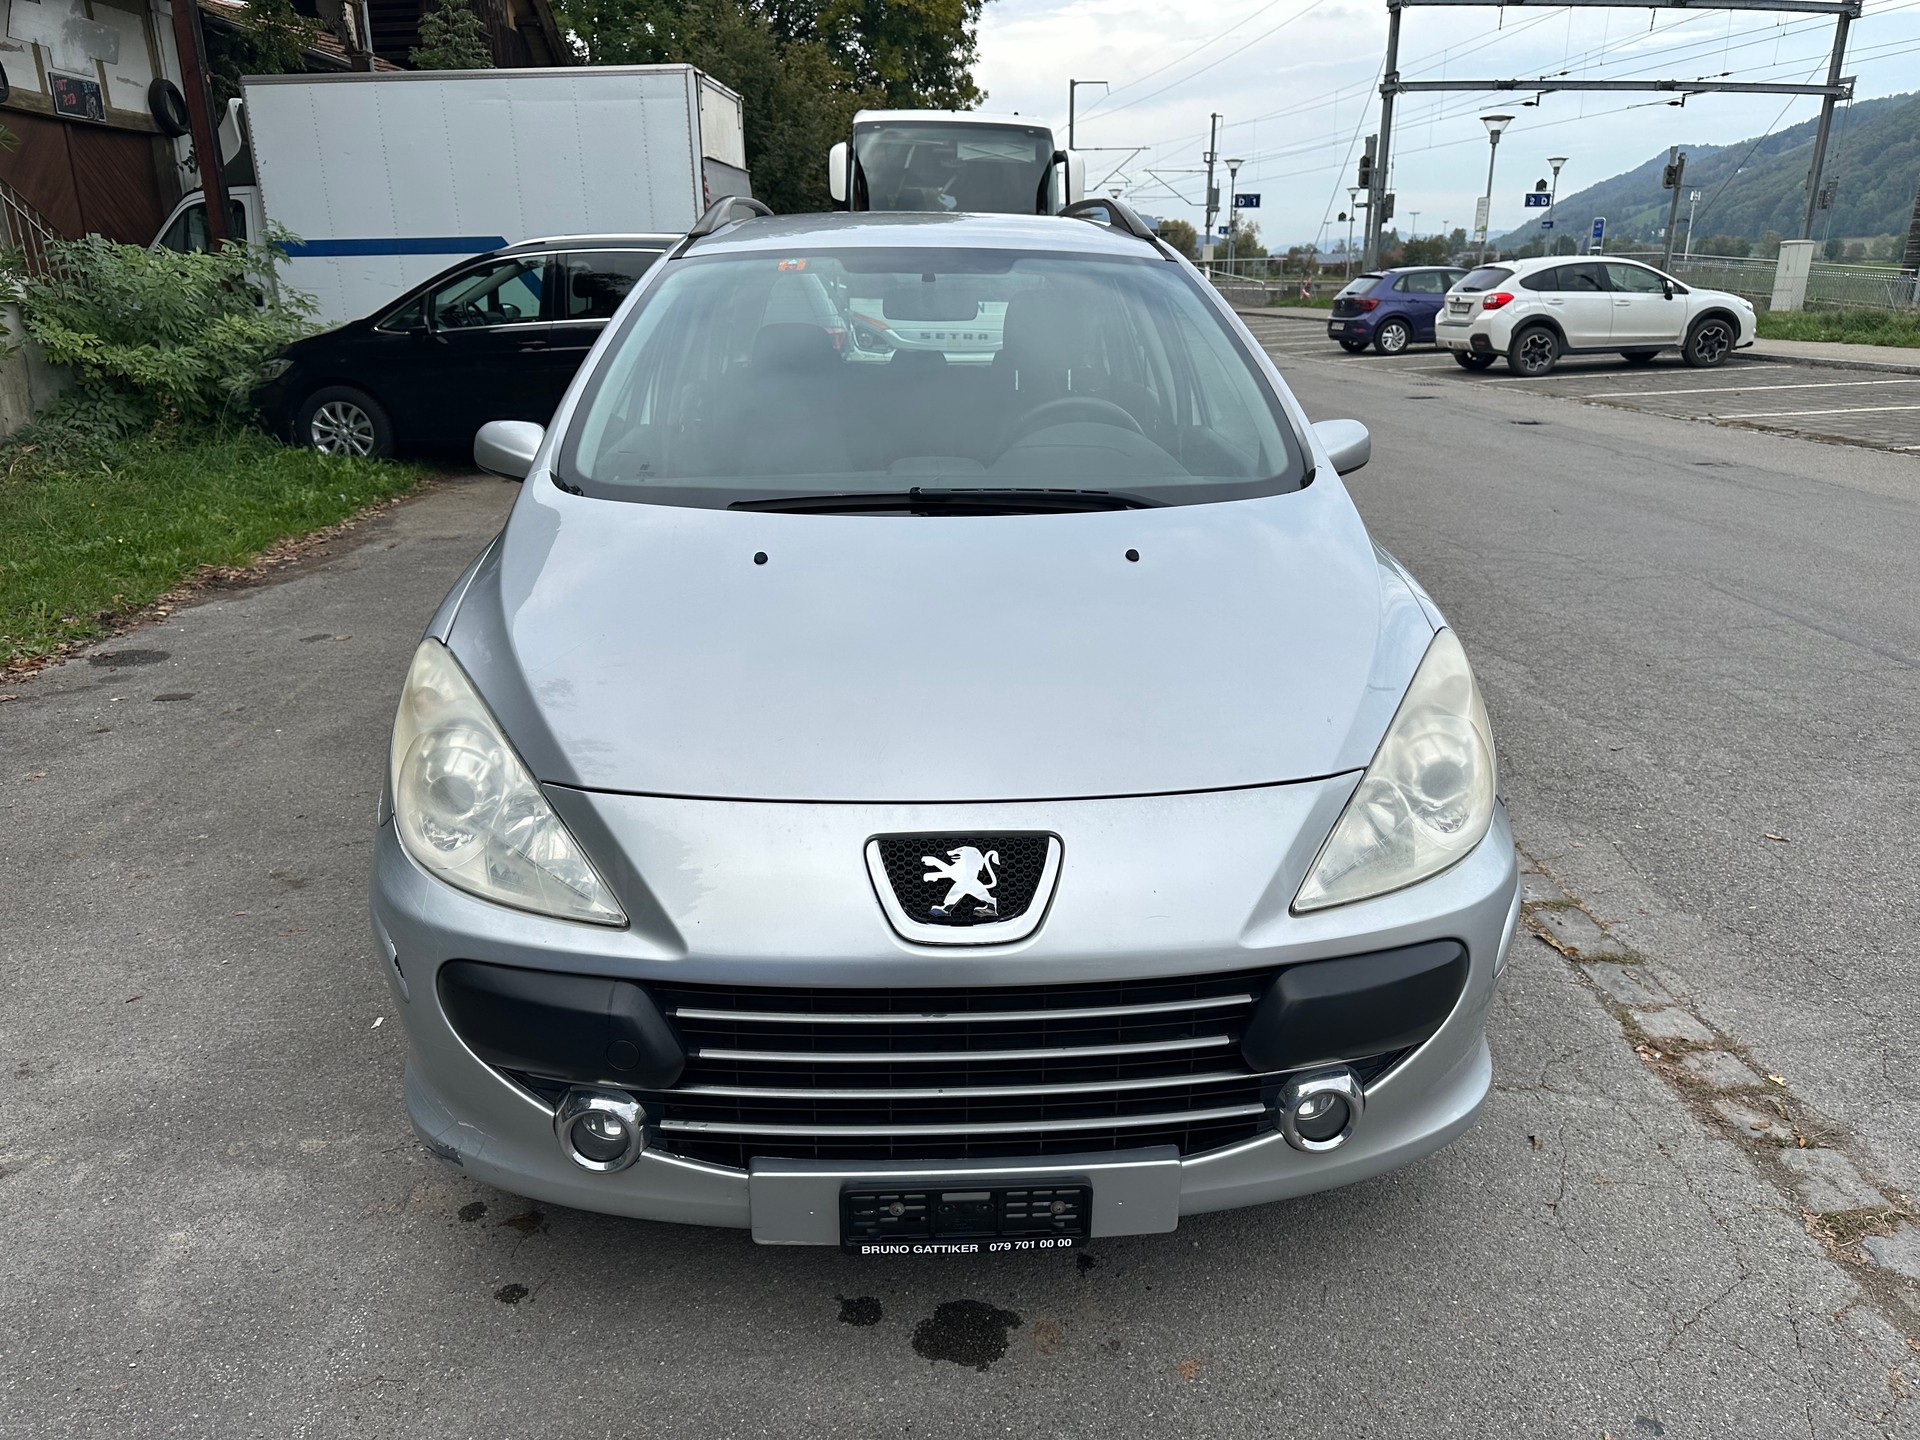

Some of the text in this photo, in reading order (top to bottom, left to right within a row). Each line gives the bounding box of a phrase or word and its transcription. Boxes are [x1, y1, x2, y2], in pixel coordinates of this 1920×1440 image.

[1238, 198, 1257, 206] D 1
[1529, 197, 1548, 206] 2 D
[920, 332, 989, 341] SETRA
[861, 1238, 1073, 1255] BRUNO GATTIKER 079 701 00 00
